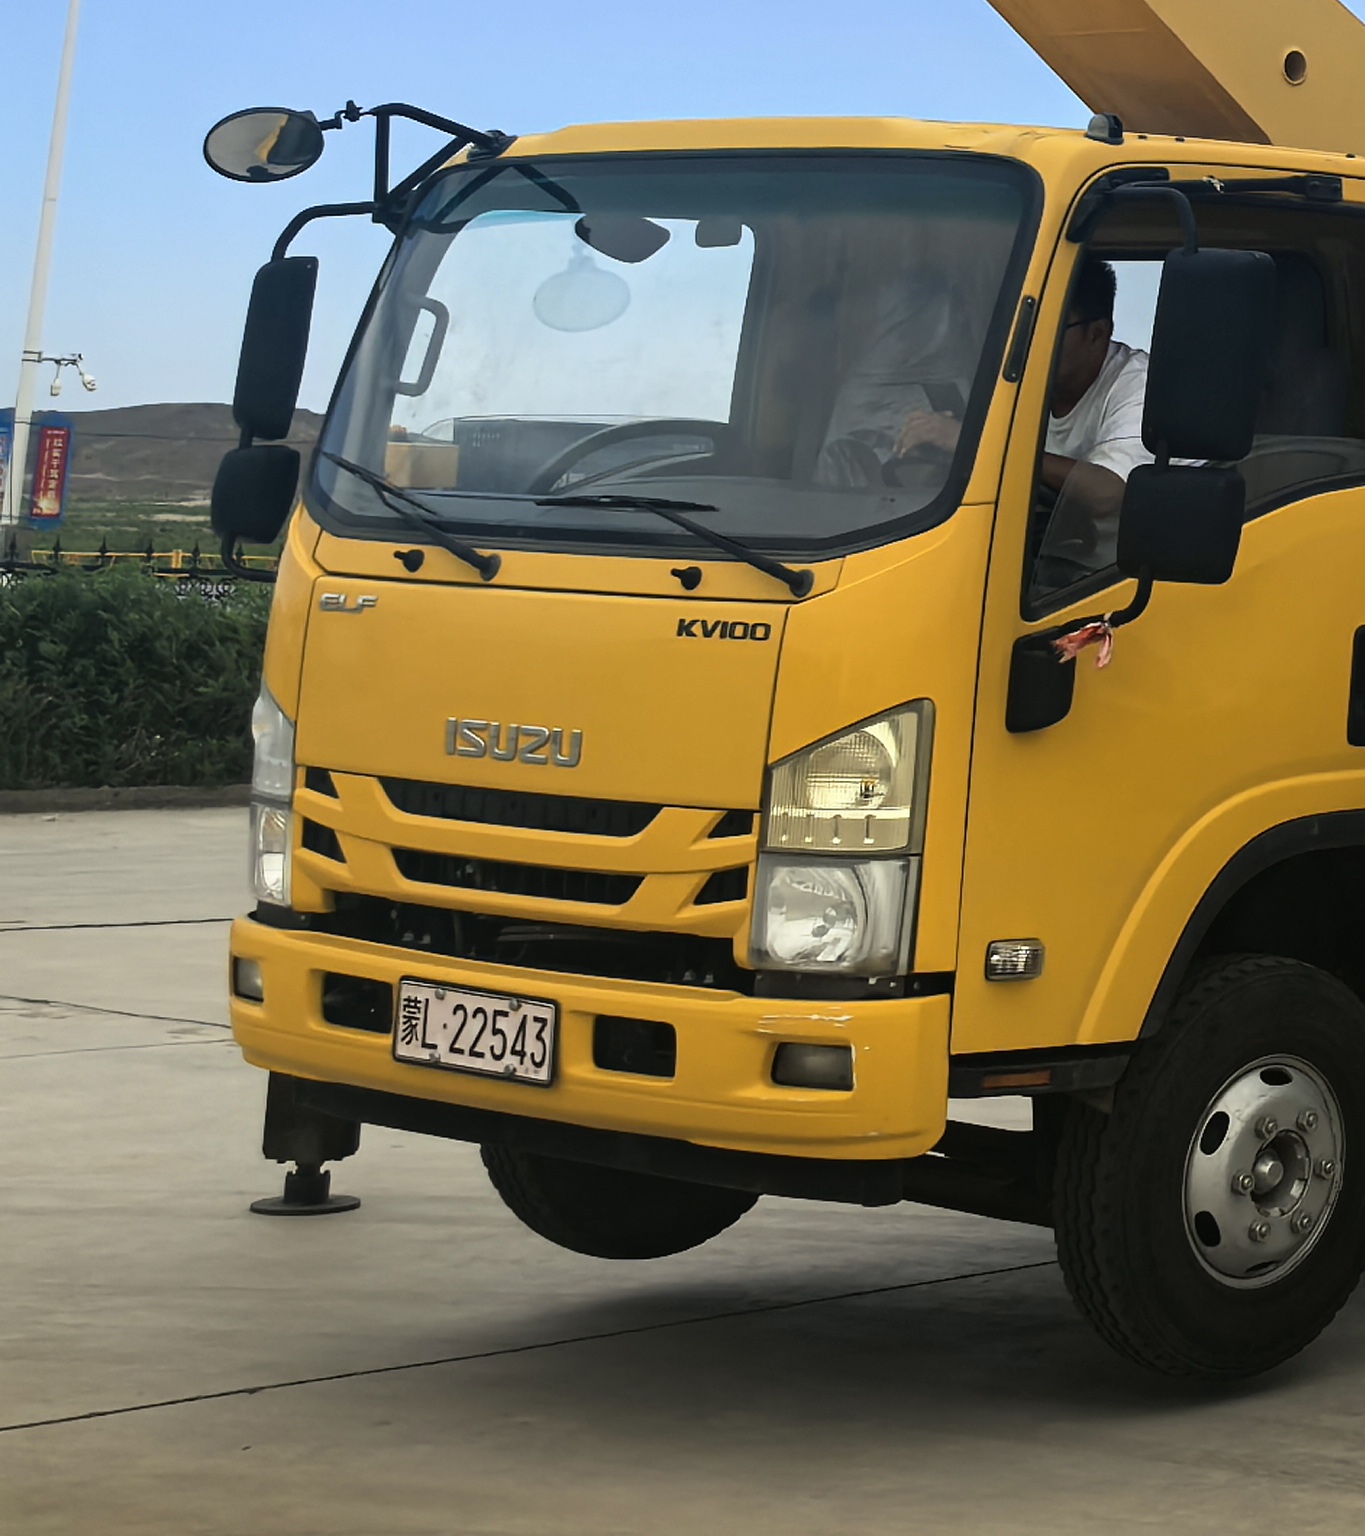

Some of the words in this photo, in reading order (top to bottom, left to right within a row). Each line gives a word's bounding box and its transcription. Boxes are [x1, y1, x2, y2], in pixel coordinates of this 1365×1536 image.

[318, 592, 379, 614] ELF
[675, 617, 772, 642] KV100
[444, 715, 583, 768] ISUZU
